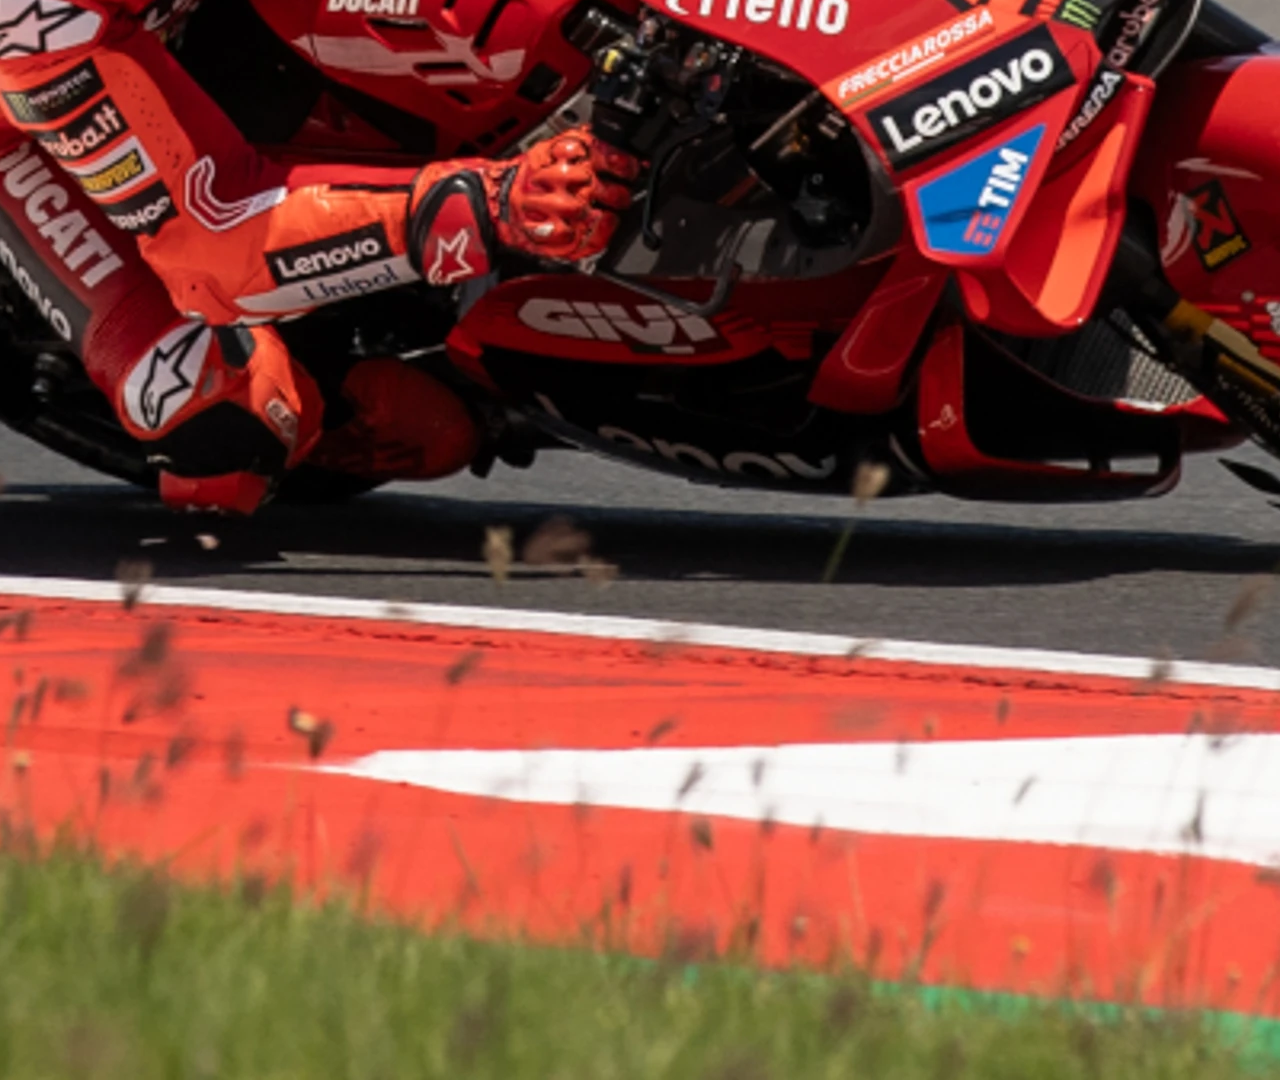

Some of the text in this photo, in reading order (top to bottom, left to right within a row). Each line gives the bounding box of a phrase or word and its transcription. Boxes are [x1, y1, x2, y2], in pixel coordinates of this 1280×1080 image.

[837, 9, 994, 99] FRECCIAROSSA
[882, 48, 1055, 154] Lenovo
[980, 146, 1029, 209] TIM
[275, 236, 382, 279] Lenovo
[301, 266, 399, 303] Unipol
[518, 298, 717, 346] GIVI
